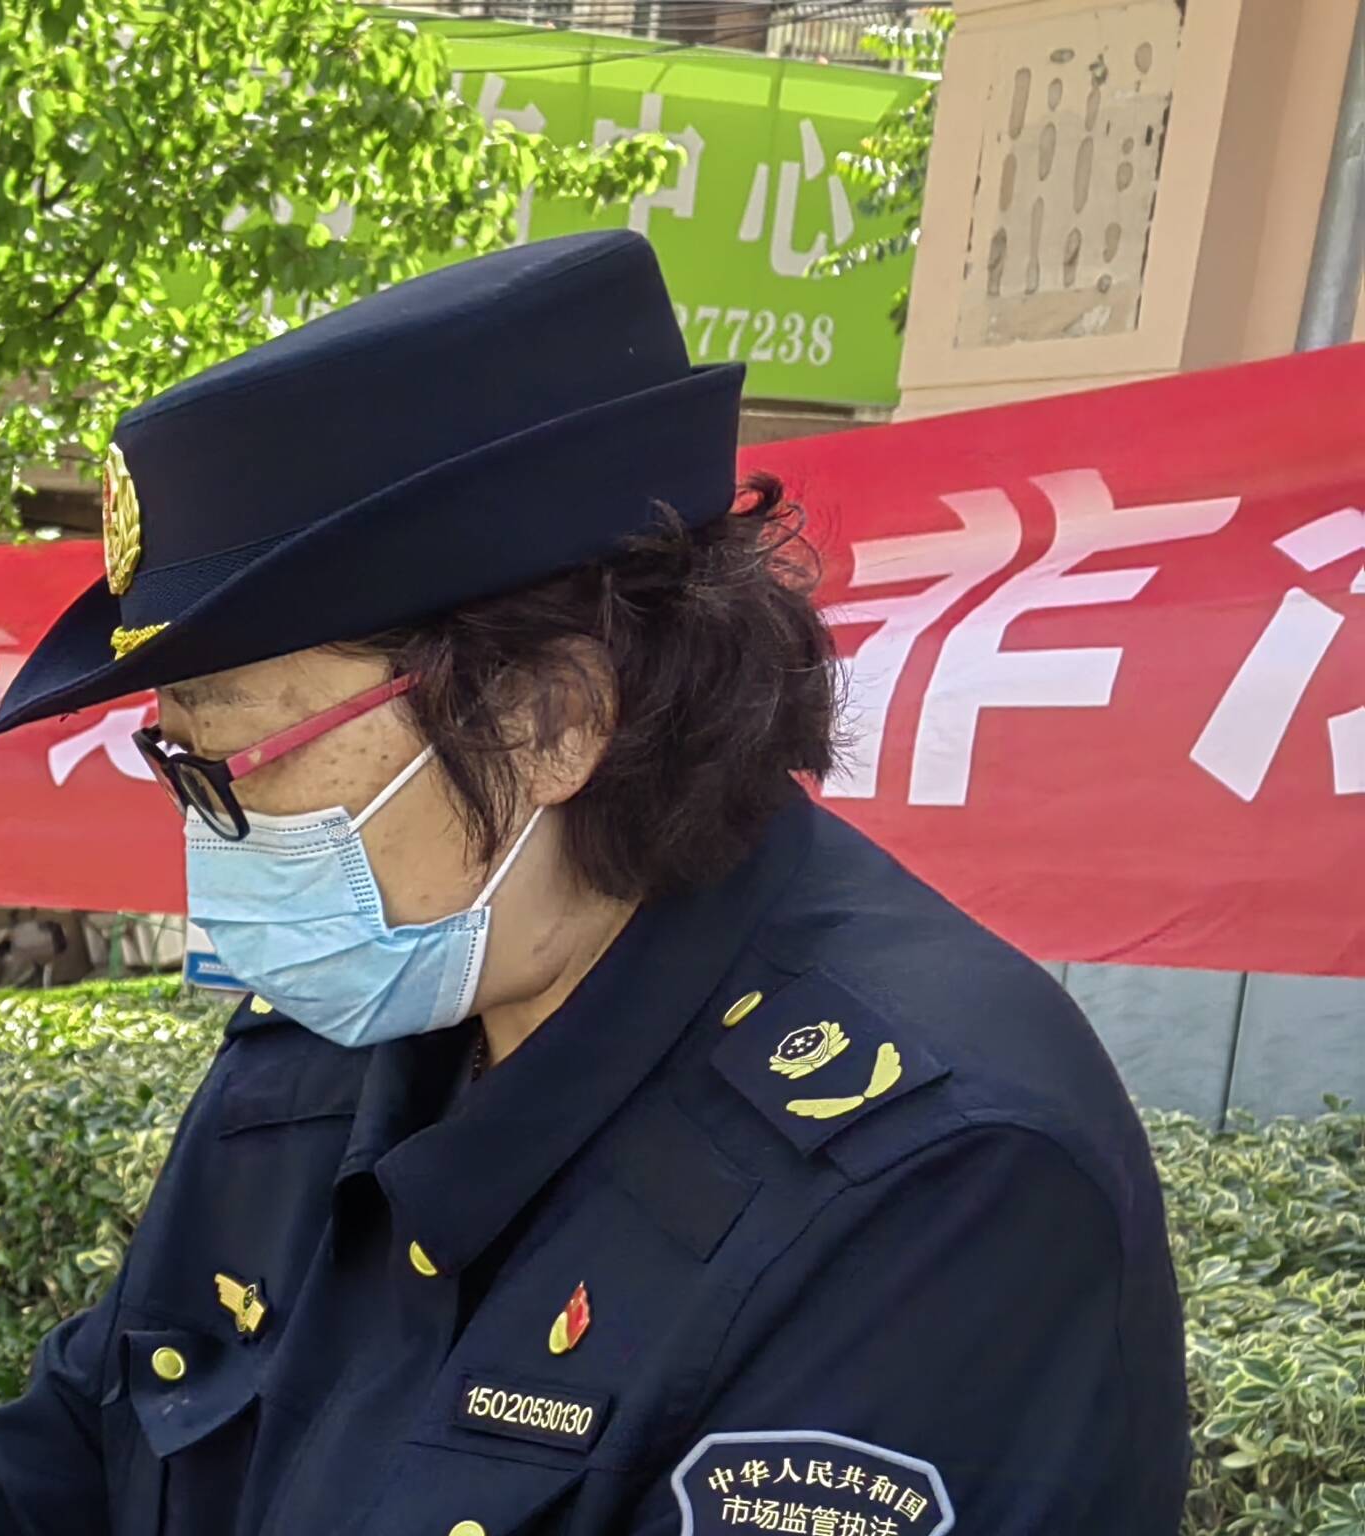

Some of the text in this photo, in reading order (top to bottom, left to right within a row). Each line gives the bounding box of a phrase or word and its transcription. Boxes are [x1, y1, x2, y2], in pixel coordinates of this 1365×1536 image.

[467, 1385, 593, 1435] 15020530130
[707, 1457, 928, 1522] 中华人民共和国
